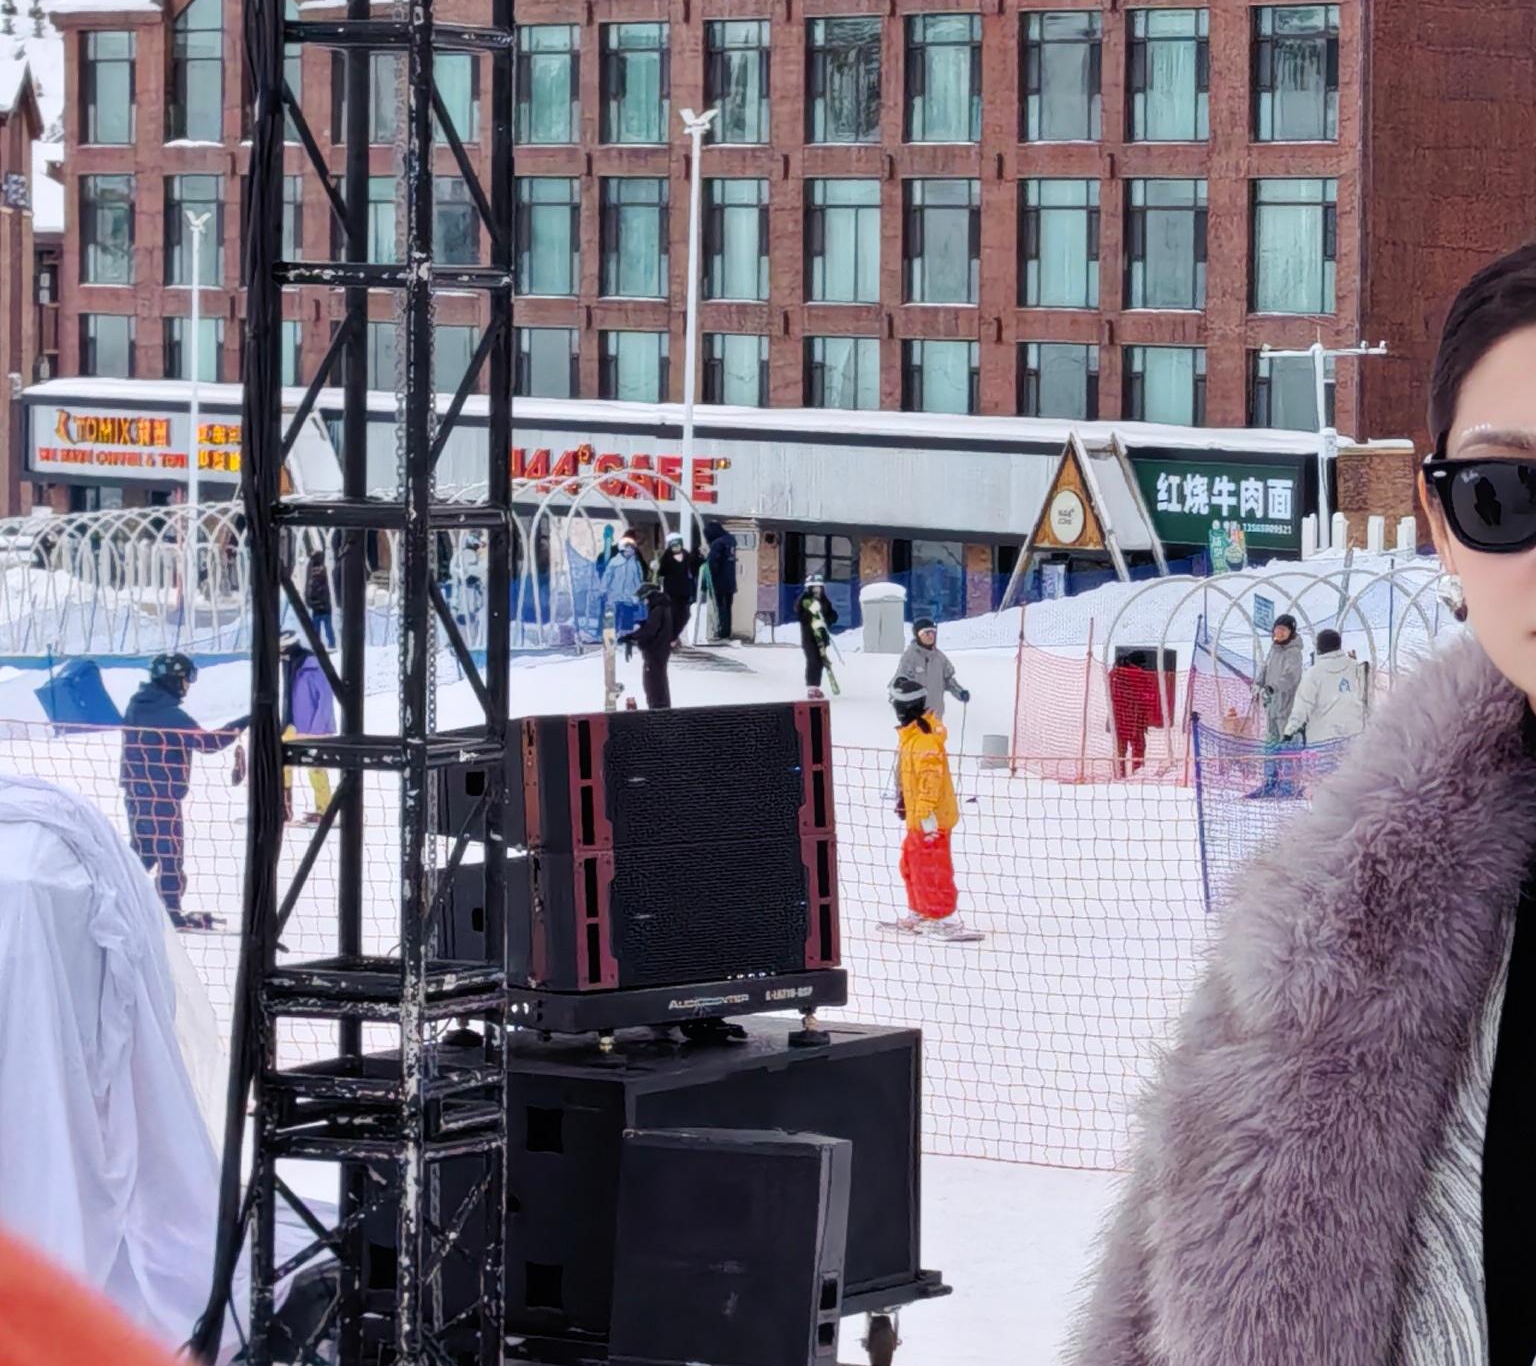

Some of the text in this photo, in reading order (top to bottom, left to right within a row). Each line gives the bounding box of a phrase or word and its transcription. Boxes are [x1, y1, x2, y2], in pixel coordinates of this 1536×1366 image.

[1156, 472, 1294, 520] 红烧牛肉面
